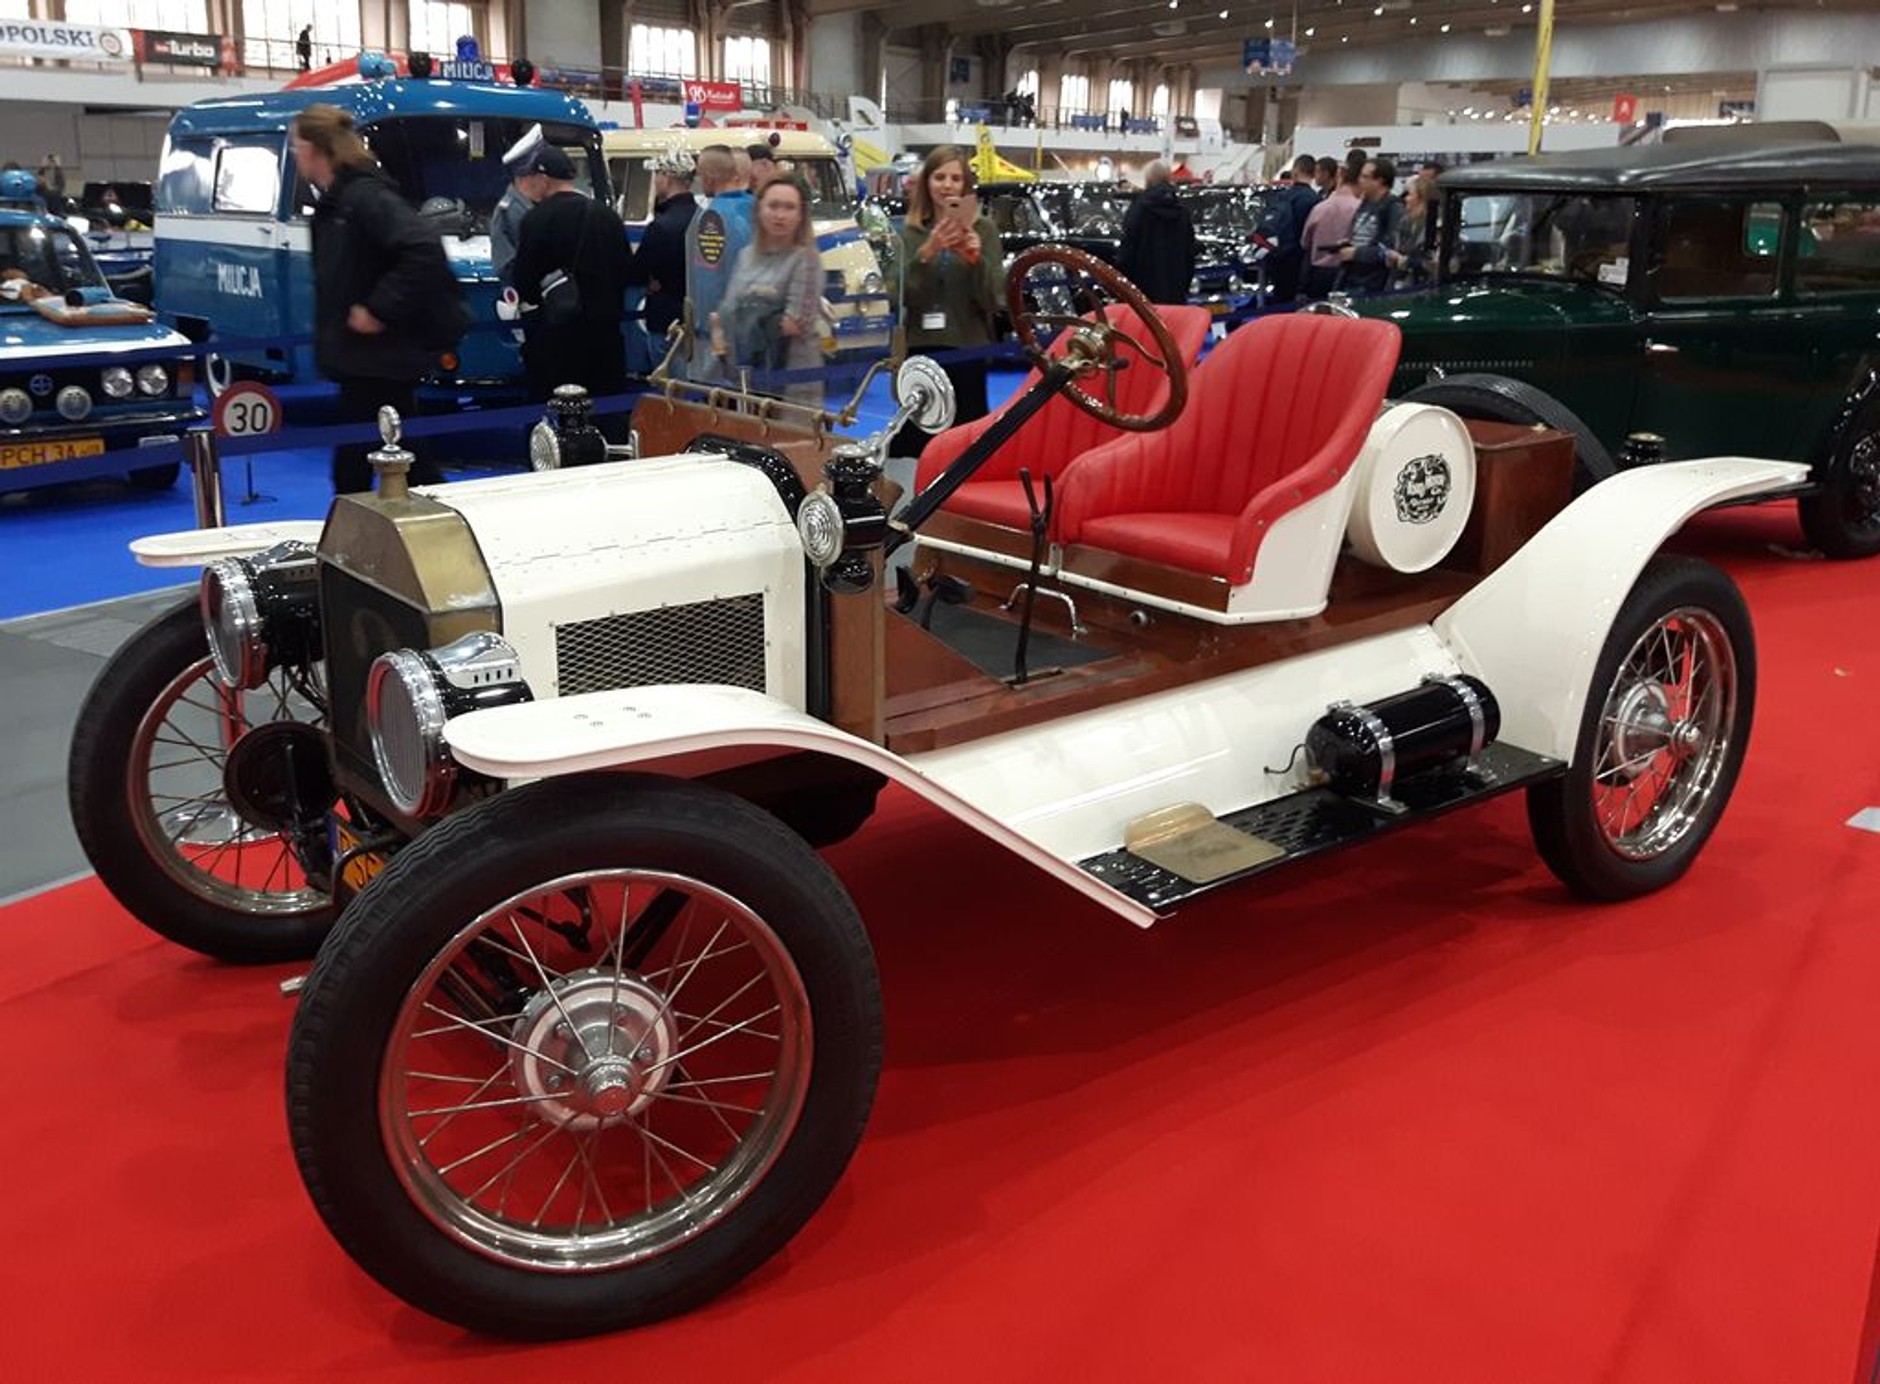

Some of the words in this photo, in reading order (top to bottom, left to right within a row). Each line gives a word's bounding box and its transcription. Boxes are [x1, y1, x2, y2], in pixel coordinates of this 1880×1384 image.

[169, 40, 215, 58] Turbo
[218, 263, 263, 299] MILICJA
[231, 402, 268, 433] 30
[1, 444, 46, 466] PCH
